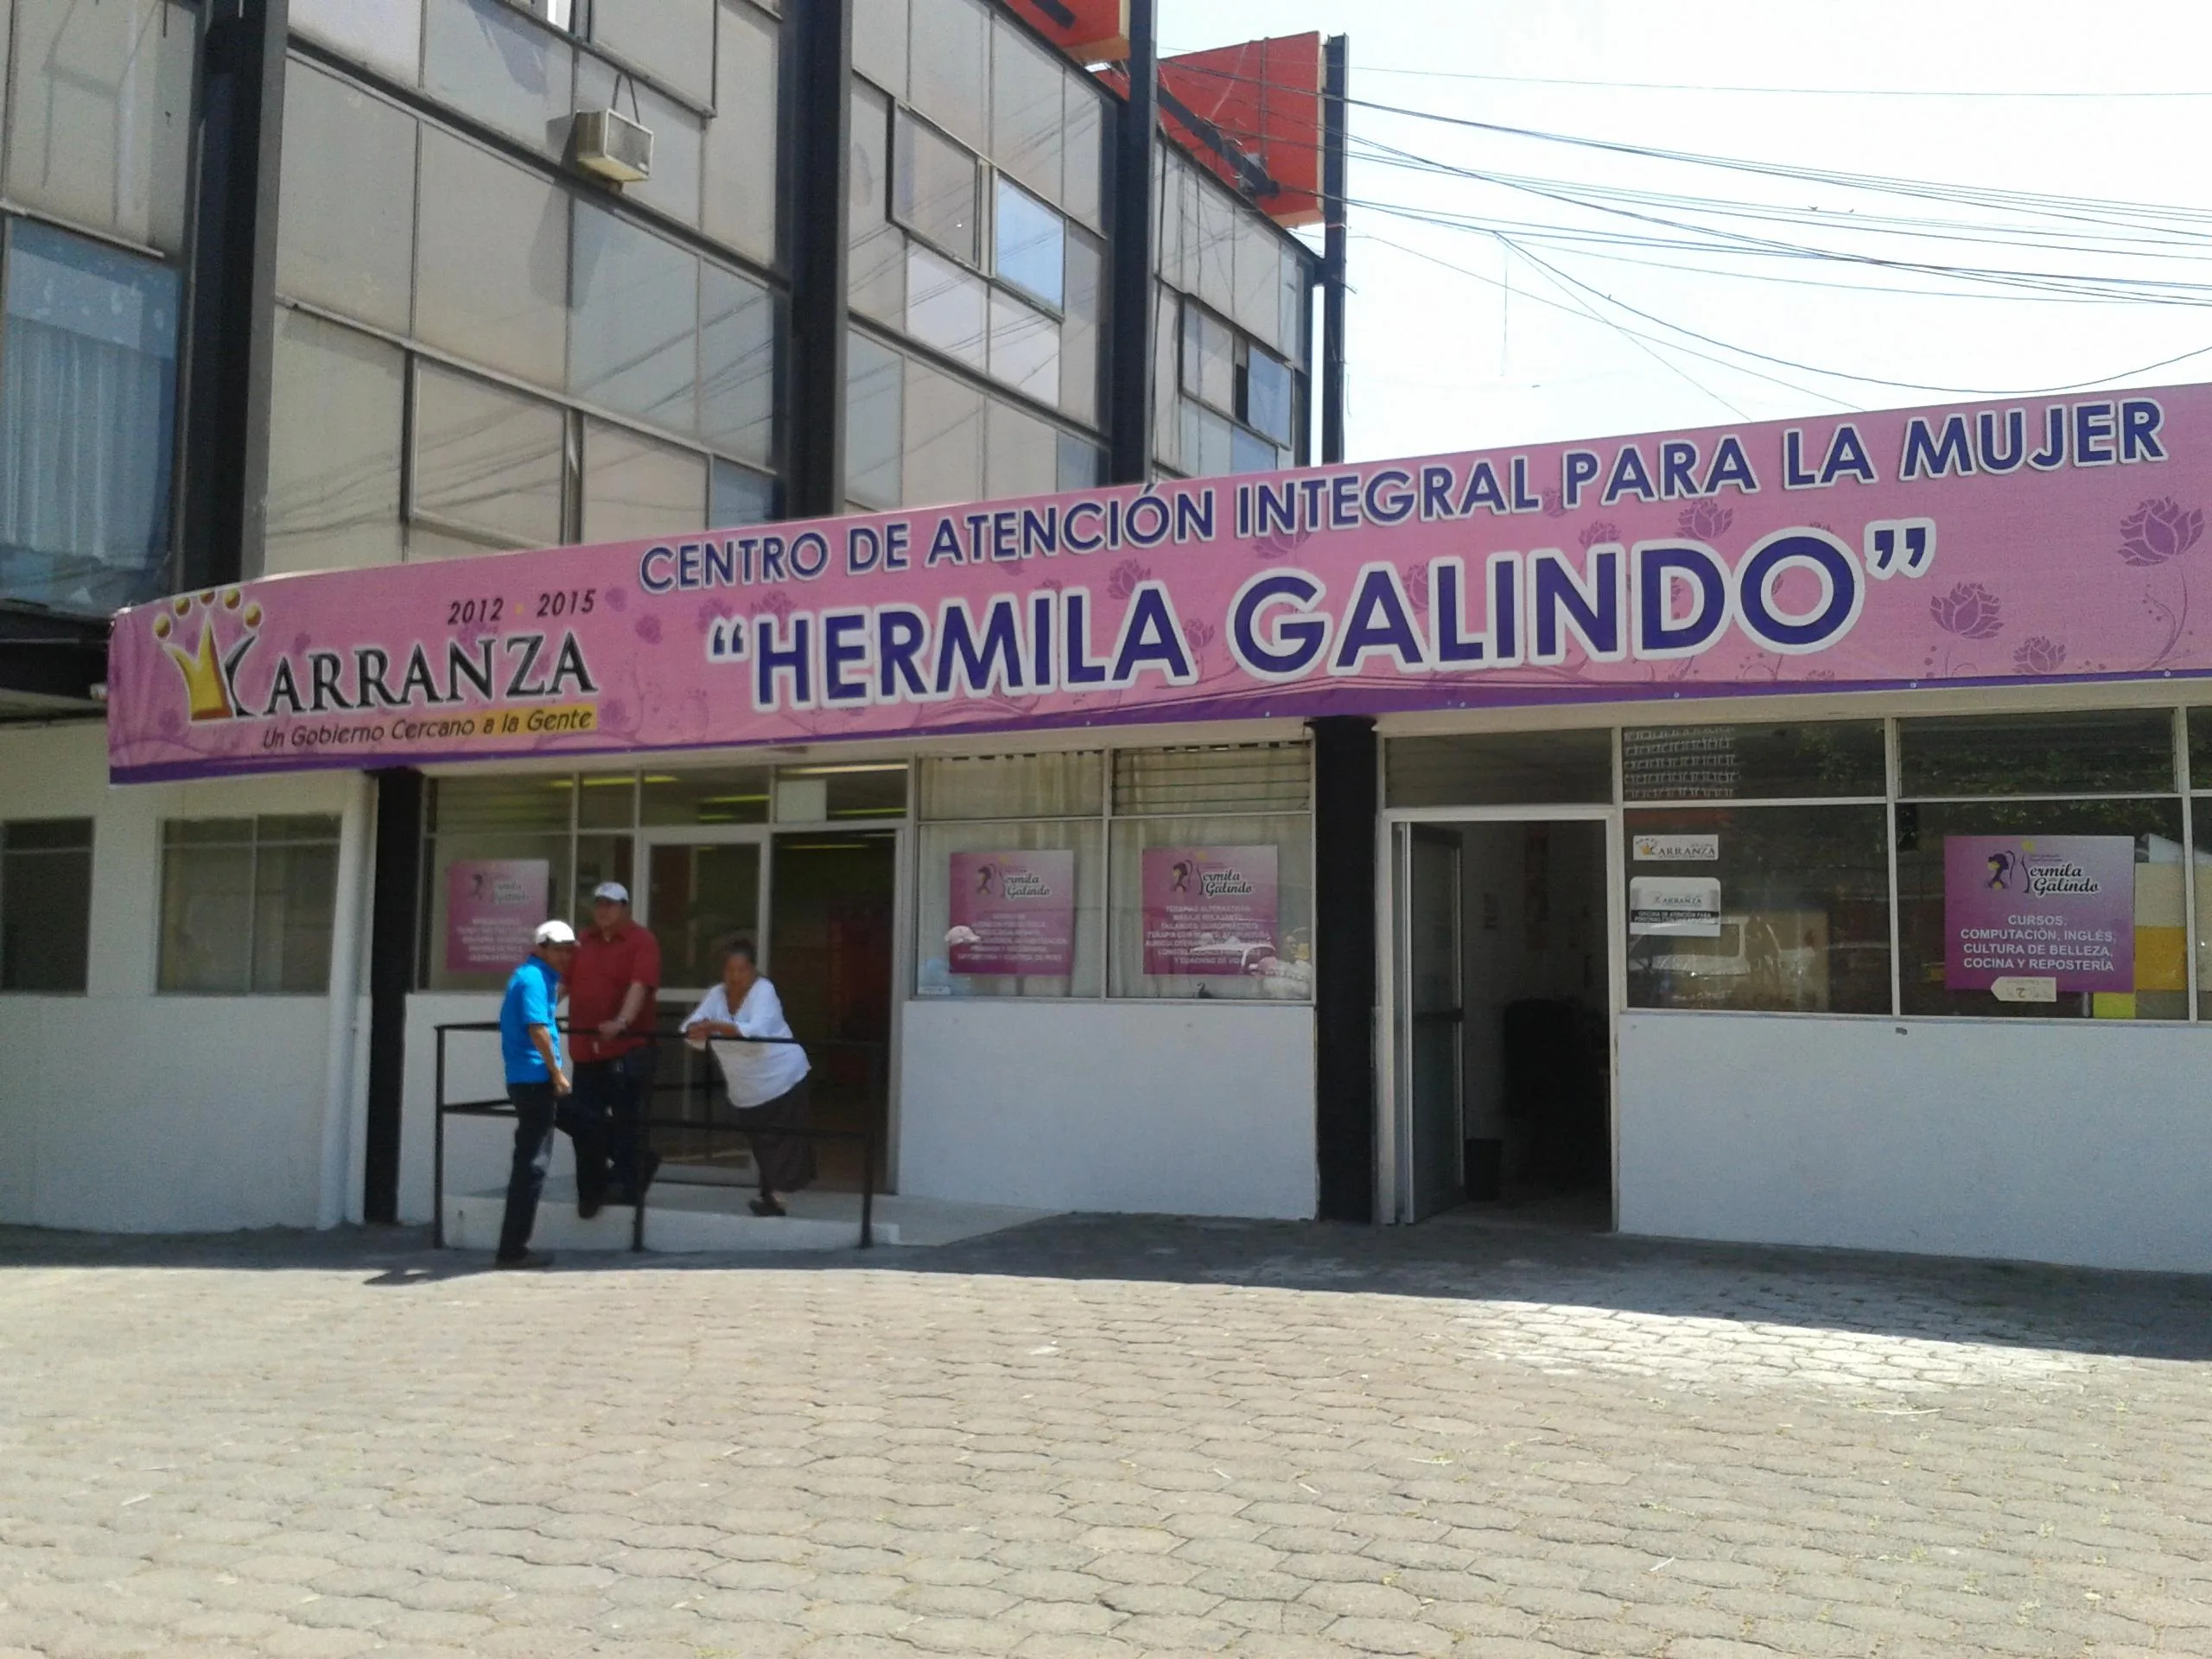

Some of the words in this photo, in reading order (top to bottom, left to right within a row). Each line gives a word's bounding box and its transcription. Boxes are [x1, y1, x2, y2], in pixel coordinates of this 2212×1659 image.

[640, 531, 830, 593] CENTRO
[848, 522, 910, 574] DE
[926, 485, 1215, 567] ATENCIÓN
[1236, 456, 1541, 537] INTEGRAL
[1563, 435, 1759, 508] PARA
[1784, 423, 1877, 489] LA
[1902, 398, 2168, 480] MUJER
[447, 598, 504, 626] 2012
[536, 588, 597, 618] 2015
[263, 728, 284, 750] Un
[291, 721, 385, 747] Gobierno
[391, 716, 475, 740] Cercano
[482, 720, 495, 735] a
[501, 712, 520, 734] la
[527, 709, 593, 733] Gente
[2033, 876, 2100, 896] Galindo
[1963, 943, 2025, 955] CULTURA
[2027, 944, 2047, 956] DE
[1963, 957, 2016, 969] COCINA
[2017, 958, 2026, 969] Y
[2029, 958, 2114, 971] REPOSTERÍA
